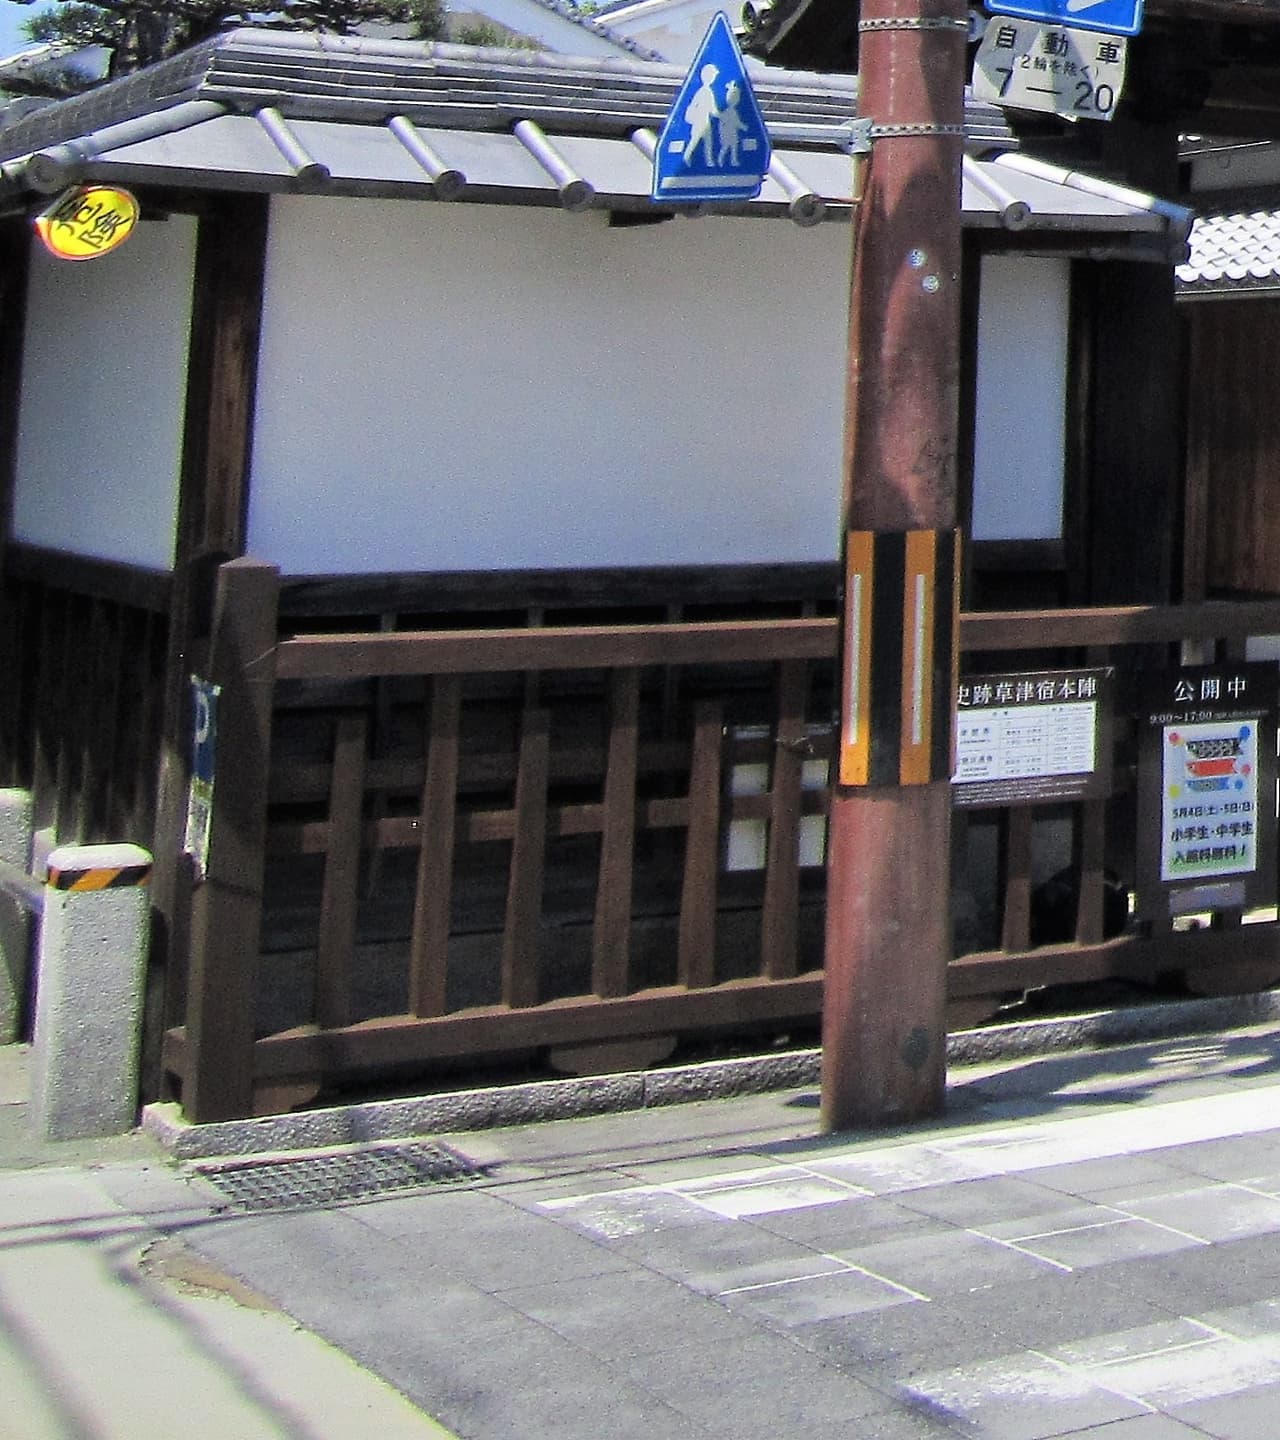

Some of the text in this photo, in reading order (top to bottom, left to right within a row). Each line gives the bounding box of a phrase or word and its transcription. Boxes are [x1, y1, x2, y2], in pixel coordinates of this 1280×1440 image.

[995, 25, 1121, 65] 自動車
[1173, 676, 1246, 702] 公開中
